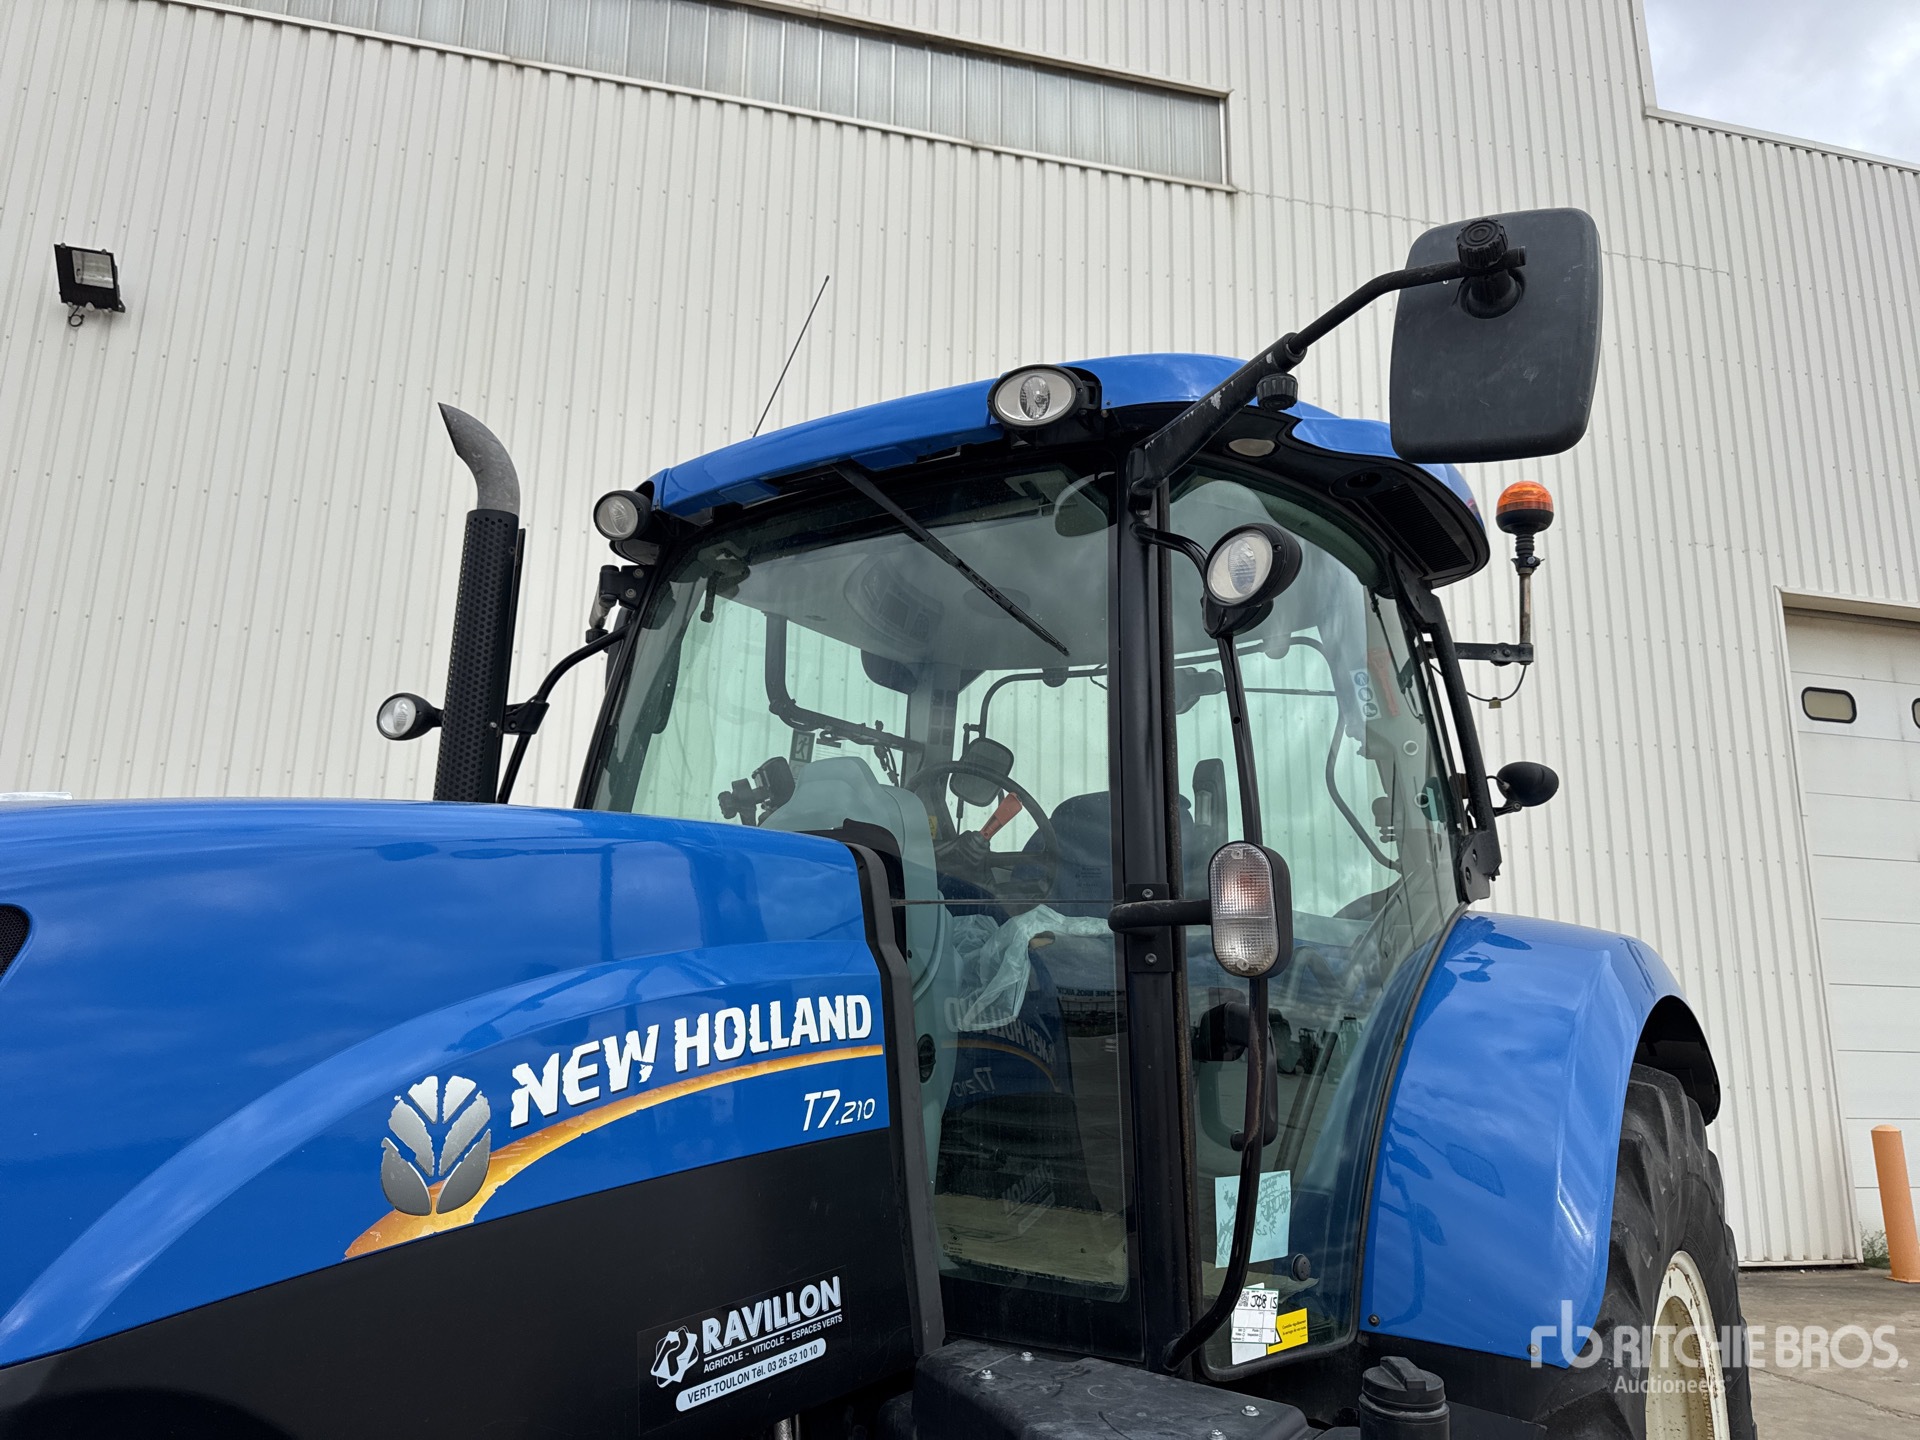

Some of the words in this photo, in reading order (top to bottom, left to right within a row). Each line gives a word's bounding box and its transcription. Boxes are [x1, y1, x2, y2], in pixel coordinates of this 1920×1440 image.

[510, 1024, 660, 1128] NEW
[674, 994, 873, 1073] HOLLAND
[803, 1088, 876, 1131] T7.210
[702, 1276, 842, 1354] RAVILLON
[703, 1351, 744, 1374] AGRICOLE
[752, 1336, 785, 1355] VITICOLE
[791, 1322, 822, 1341] ESPACES
[822, 1314, 843, 1329] VERTS
[687, 1370, 750, 1404] VERT-TOULON
[751, 1363, 766, 1378] Tél.
[767, 1360, 777, 1373] 03
[778, 1356, 788, 1369] 26
[788, 1352, 798, 1365] 52
[799, 1349, 808, 1362] 10
[809, 1345, 818, 1358] 10
